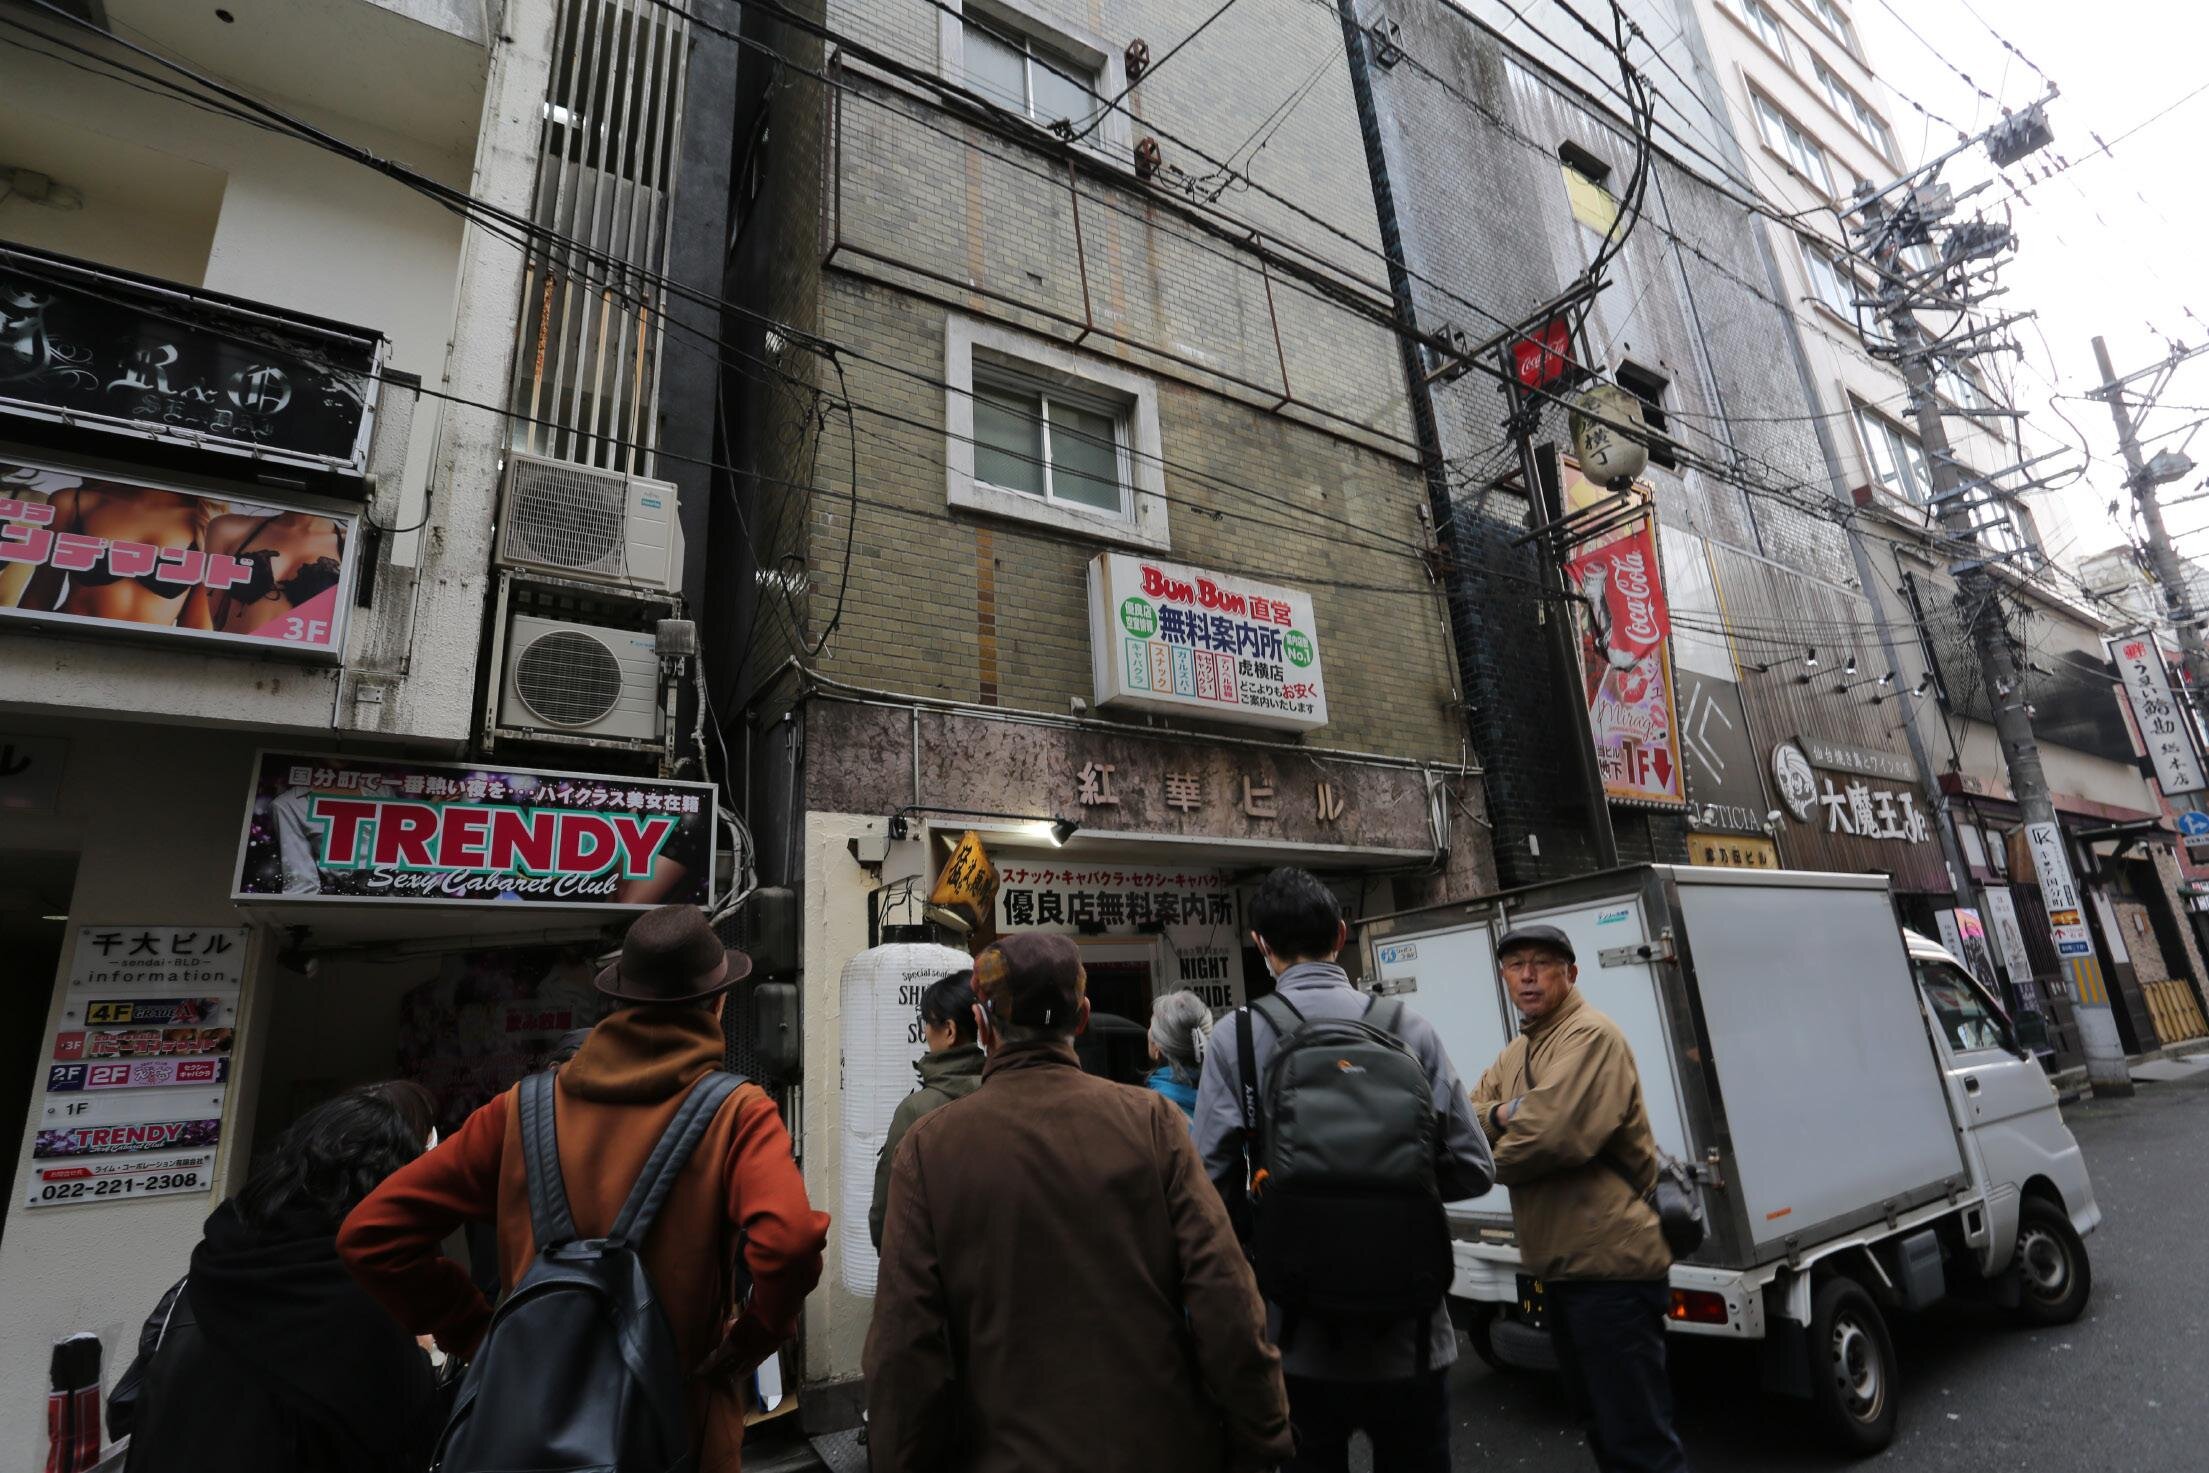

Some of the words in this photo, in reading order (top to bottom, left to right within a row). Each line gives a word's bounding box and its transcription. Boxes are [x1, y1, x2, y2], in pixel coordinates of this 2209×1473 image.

[1141, 564, 1194, 606] Bun
[1196, 575, 1248, 616] Bun
[1249, 595, 1293, 627] 直営
[283, 615, 328, 643] 3F
[1158, 604, 1283, 662] 無料案内所
[1132, 643, 1143, 684] キャバクラ
[1154, 647, 1166, 687] スナック
[1238, 659, 1283, 682] 虎横店
[1240, 681, 1317, 699] どこよりもお安く
[1241, 693, 1314, 714] ご案内いたします
[1078, 760, 1345, 822] 紅華ビル
[1820, 778, 1930, 844] 大魔王Jr.
[309, 795, 681, 880] TRENDY
[368, 865, 443, 893] Sexy
[440, 869, 554, 897] Cabaret
[553, 872, 618, 897] Club
[1003, 888, 1233, 926] 優良店無料案内所
[92, 932, 232, 956] 千大ビル
[88, 970, 225, 983] information
[902, 968, 931, 982] Special
[1179, 957, 1229, 980] NIGHT
[93, 1005, 131, 1020] 4F
[52, 1066, 82, 1081] 2F
[92, 1066, 128, 1085] 2F
[66, 1102, 88, 1115] 1F
[76, 1123, 184, 1149] TRENDY
[42, 1173, 197, 1200] 022-221-2308
